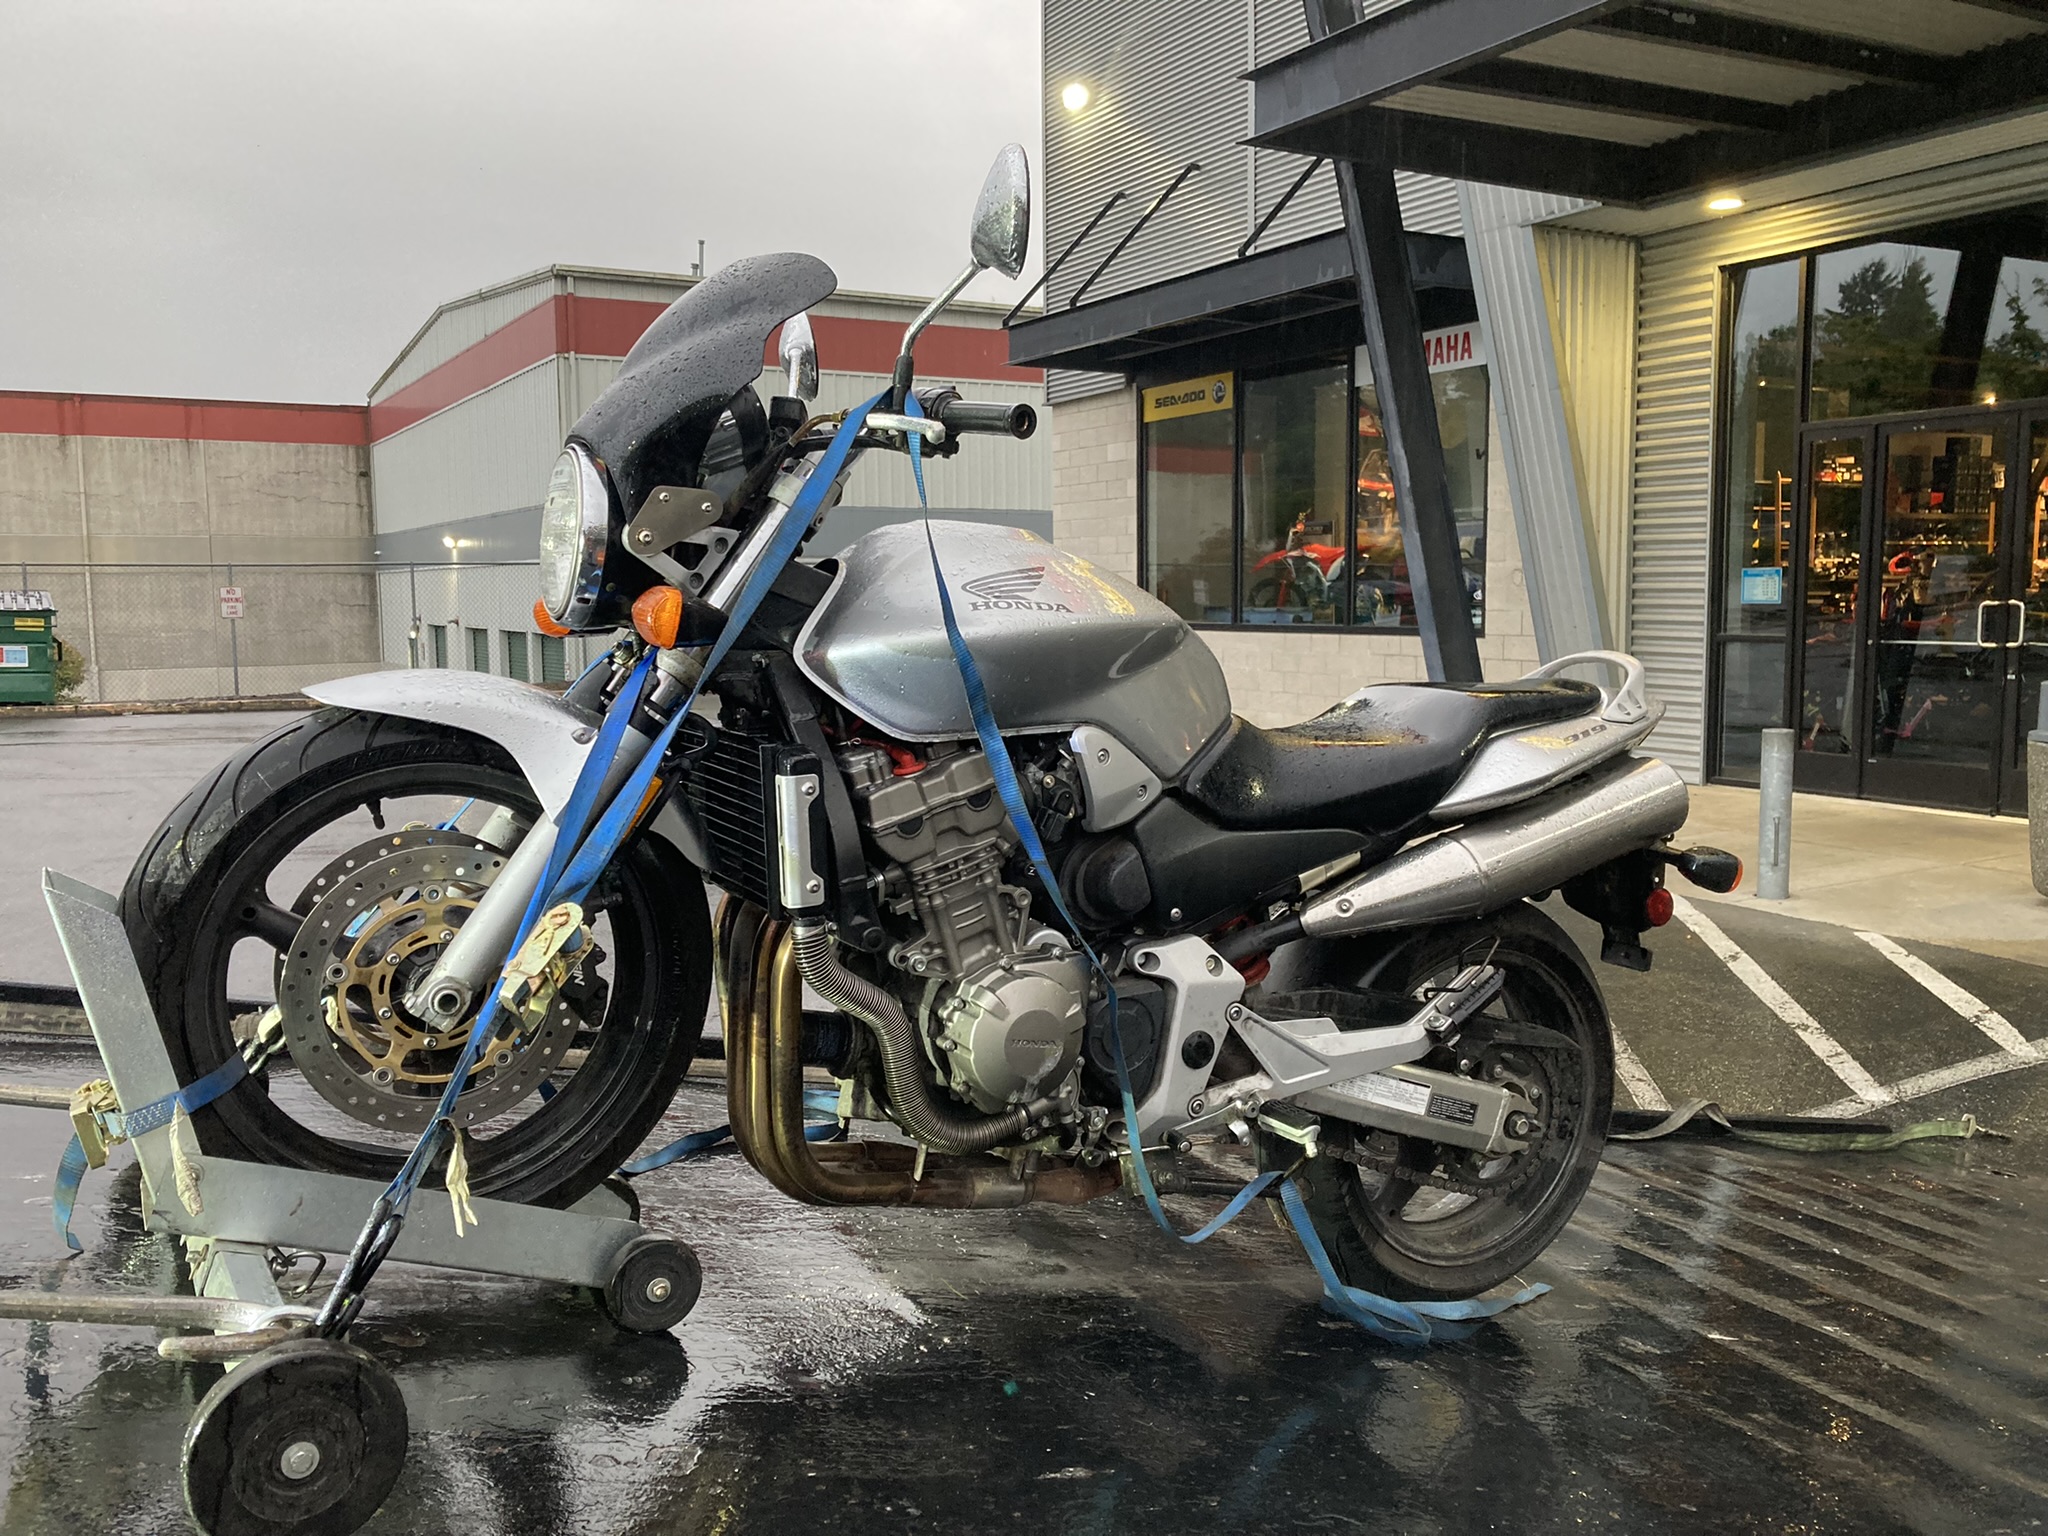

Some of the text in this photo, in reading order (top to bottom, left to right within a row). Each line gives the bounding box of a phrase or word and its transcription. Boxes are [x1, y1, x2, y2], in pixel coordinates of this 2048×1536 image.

[968, 600, 1075, 613] HONDA
[1563, 724, 1607, 746] 919
[1011, 1039, 1058, 1049] HONDA
